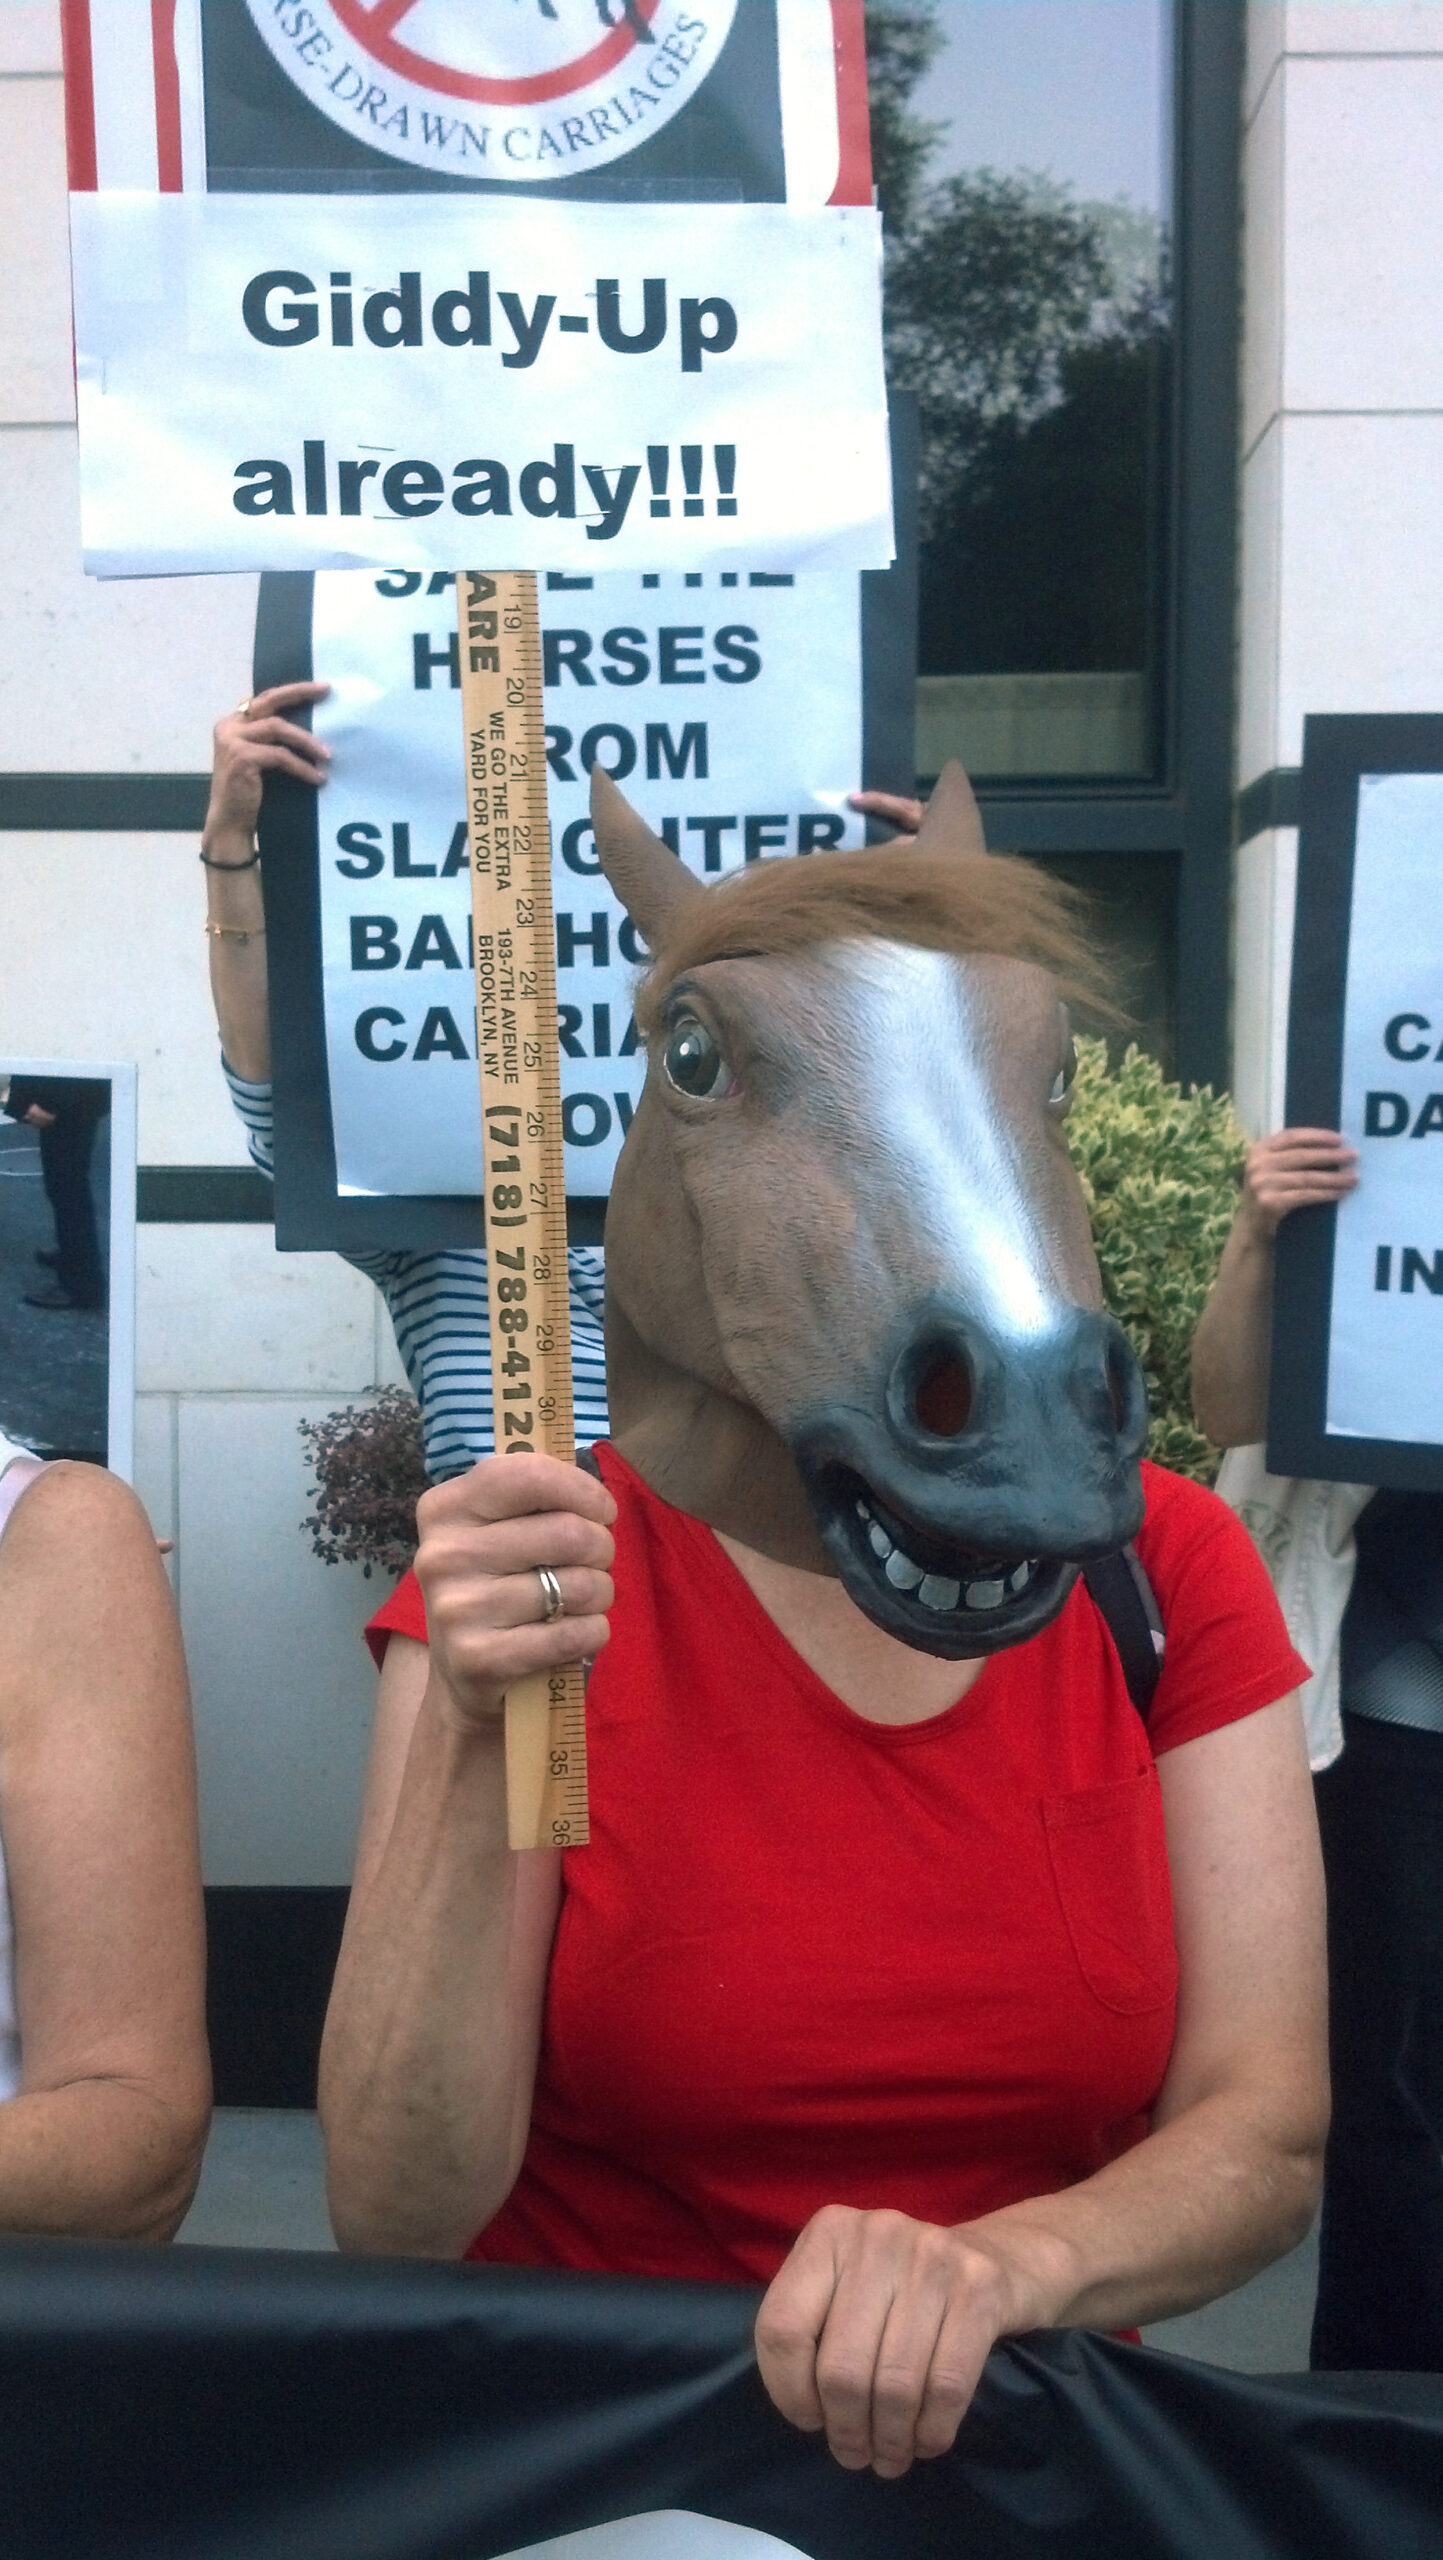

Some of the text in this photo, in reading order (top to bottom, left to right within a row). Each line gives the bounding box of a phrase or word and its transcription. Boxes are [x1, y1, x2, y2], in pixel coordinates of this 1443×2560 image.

[503, 13, 708, 161] CARRIAGES
[241, 270, 738, 372] Giddy-Up
[232, 440, 738, 541] already!!!
[504, 604, 523, 630] 19
[413, 625, 761, 690] HRSES
[506, 678, 525, 704] 20
[544, 722, 709, 782] ROM
[510, 754, 529, 779] 21
[471, 729, 491, 874] YARD FOR YOU
[489, 711, 512, 892] WE GO THE EXTRA
[513, 825, 532, 851] 22
[516, 898, 535, 924] 23
[349, 914, 475, 971] BA
[520, 971, 538, 997] 24
[478, 935, 500, 1079] BROOKLYN, NY
[498, 929, 519, 1085] 193-7TH AVENUE
[524, 1042, 541, 1068] 25
[526, 1112, 545, 1137] 26
[485, 1105, 528, 1227] (718)
[530, 1183, 548, 1208] 27
[533, 1255, 551, 1280] 28
[536, 1325, 554, 1351] 29
[538, 1396, 556, 1422] 30
[548, 1678, 566, 1704] 34
[550, 1751, 568, 1776] 35
[552, 1820, 570, 1846] 36
